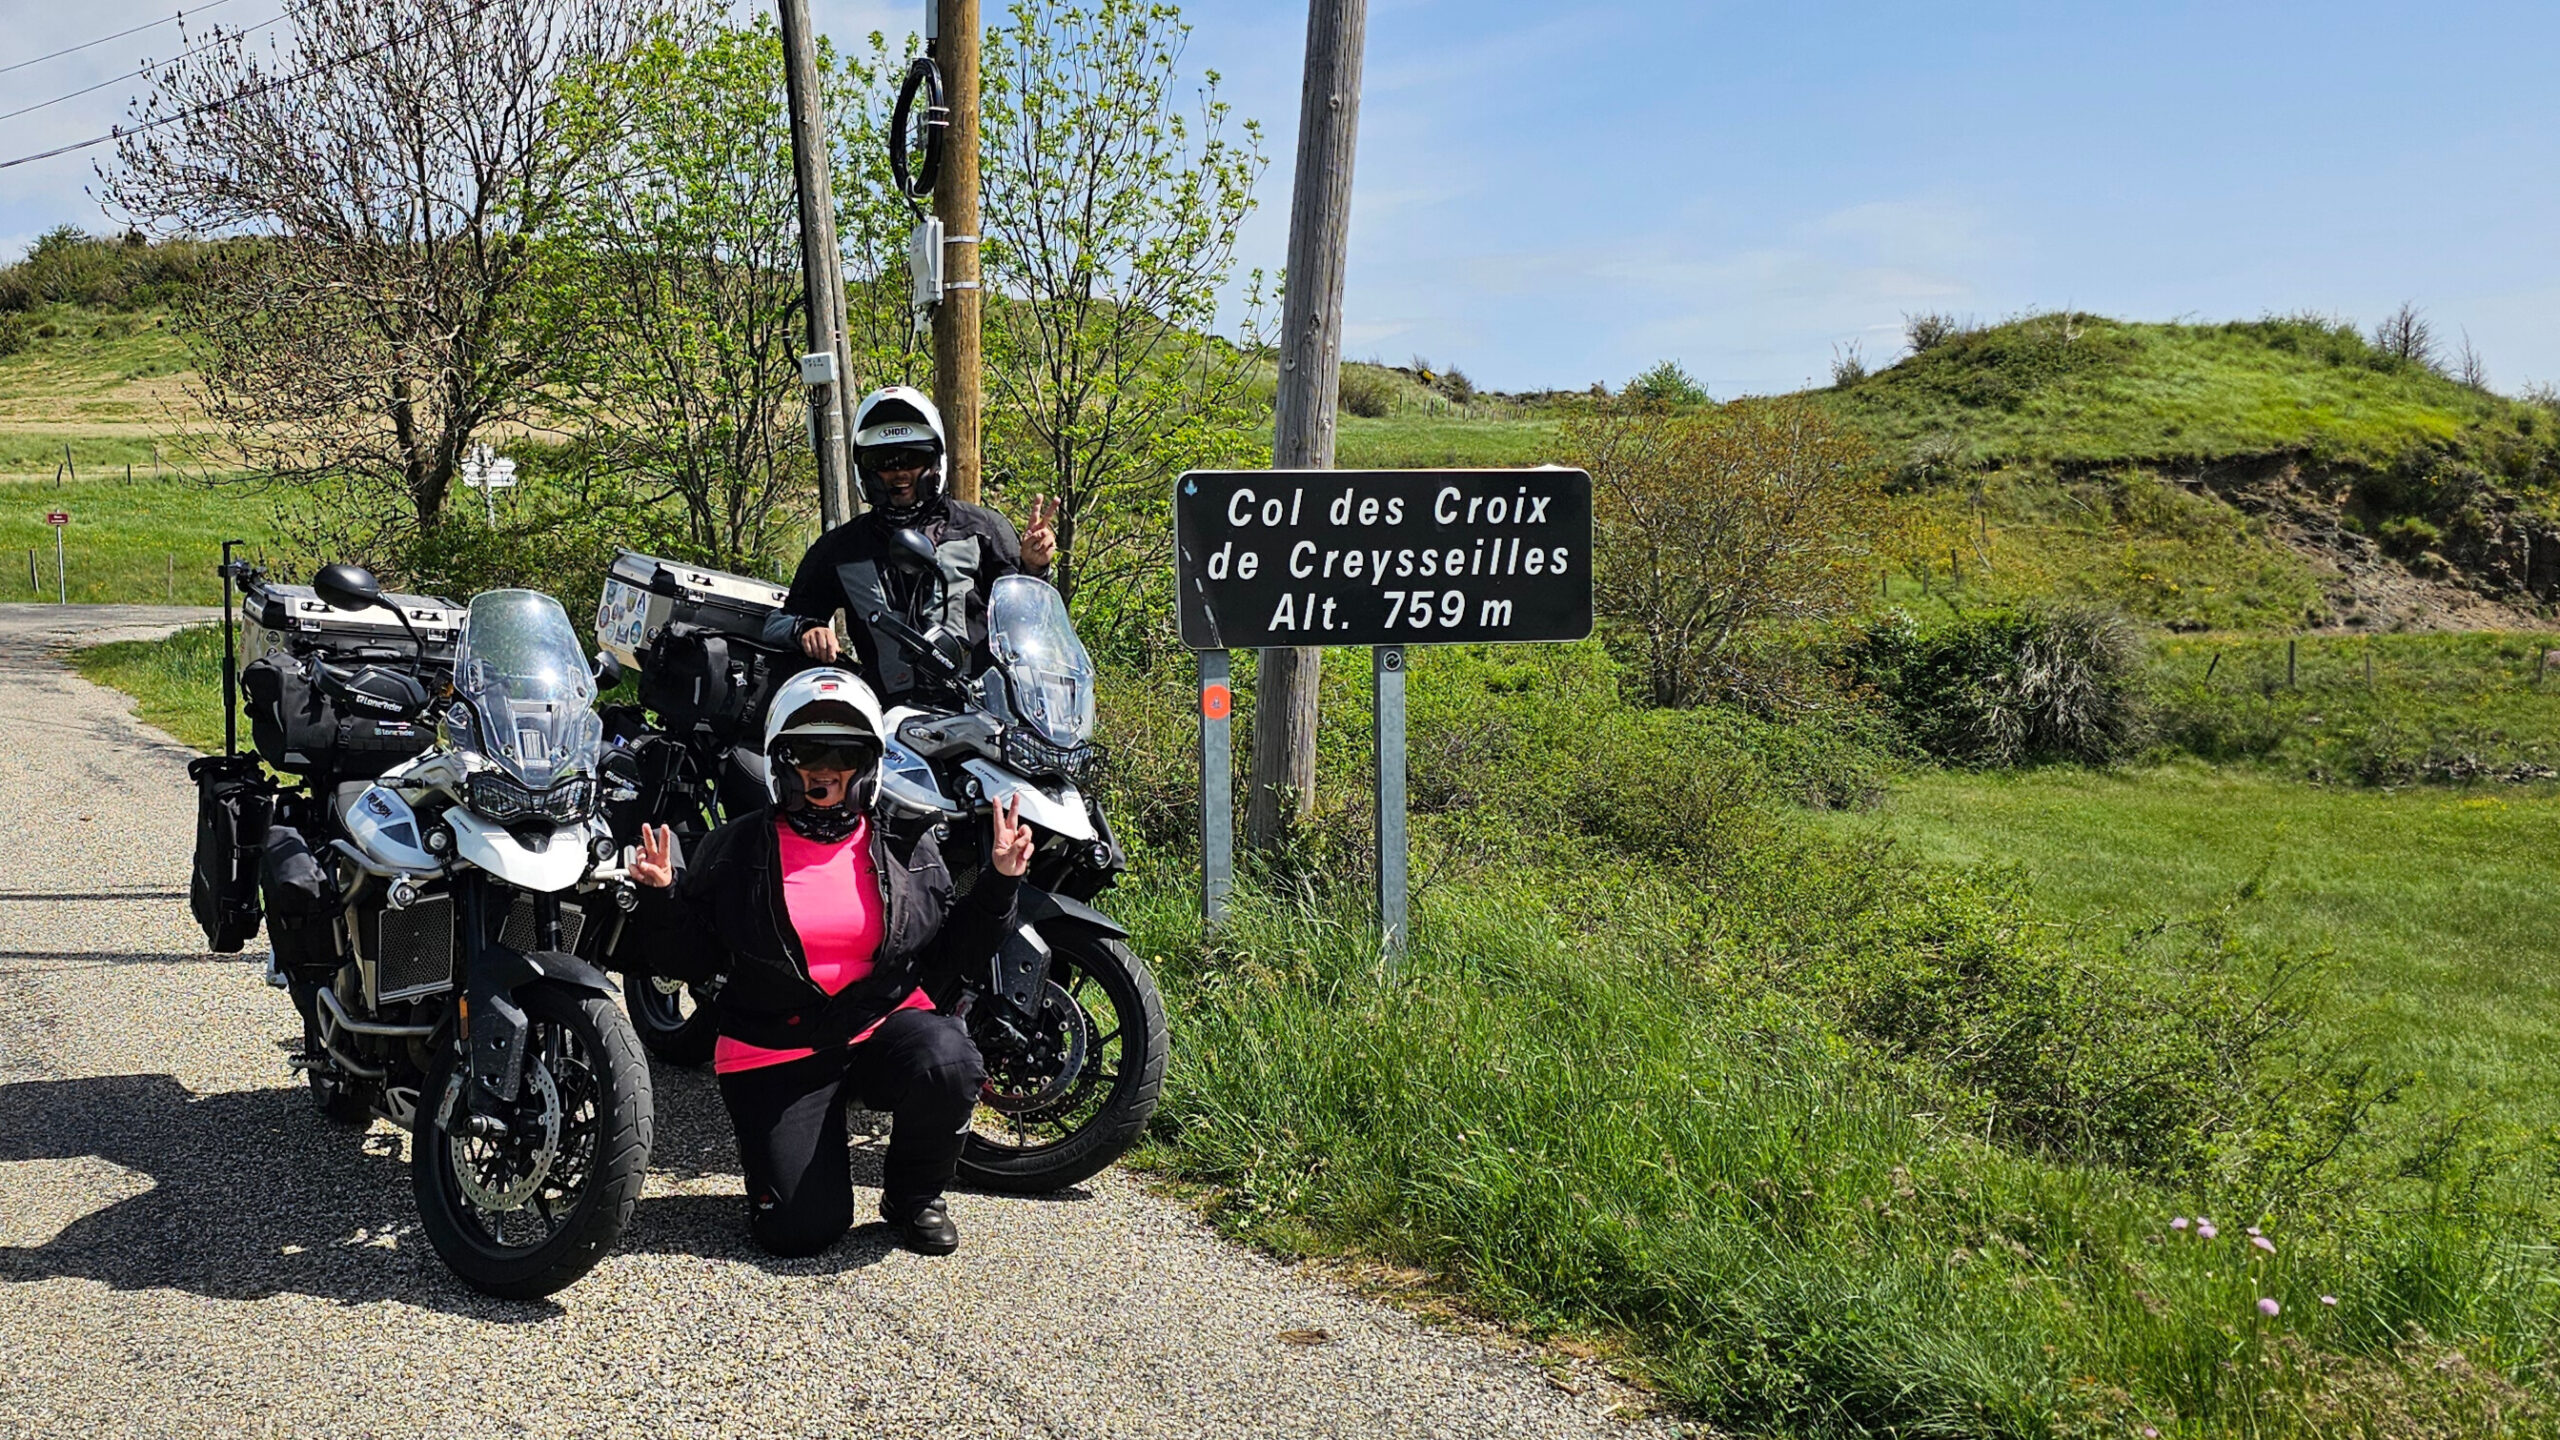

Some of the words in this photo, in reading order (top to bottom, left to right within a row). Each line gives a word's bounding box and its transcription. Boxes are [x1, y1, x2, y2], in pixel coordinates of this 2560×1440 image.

[1227, 488, 1304, 527] Col
[1329, 487, 1406, 526] des
[1434, 485, 1551, 525] Croix
[1207, 541, 1260, 581] de
[1289, 537, 1569, 586] Creysseilles
[1267, 592, 1350, 631] Alt.
[1383, 589, 1466, 629] 759
[1479, 599, 1512, 628] m
